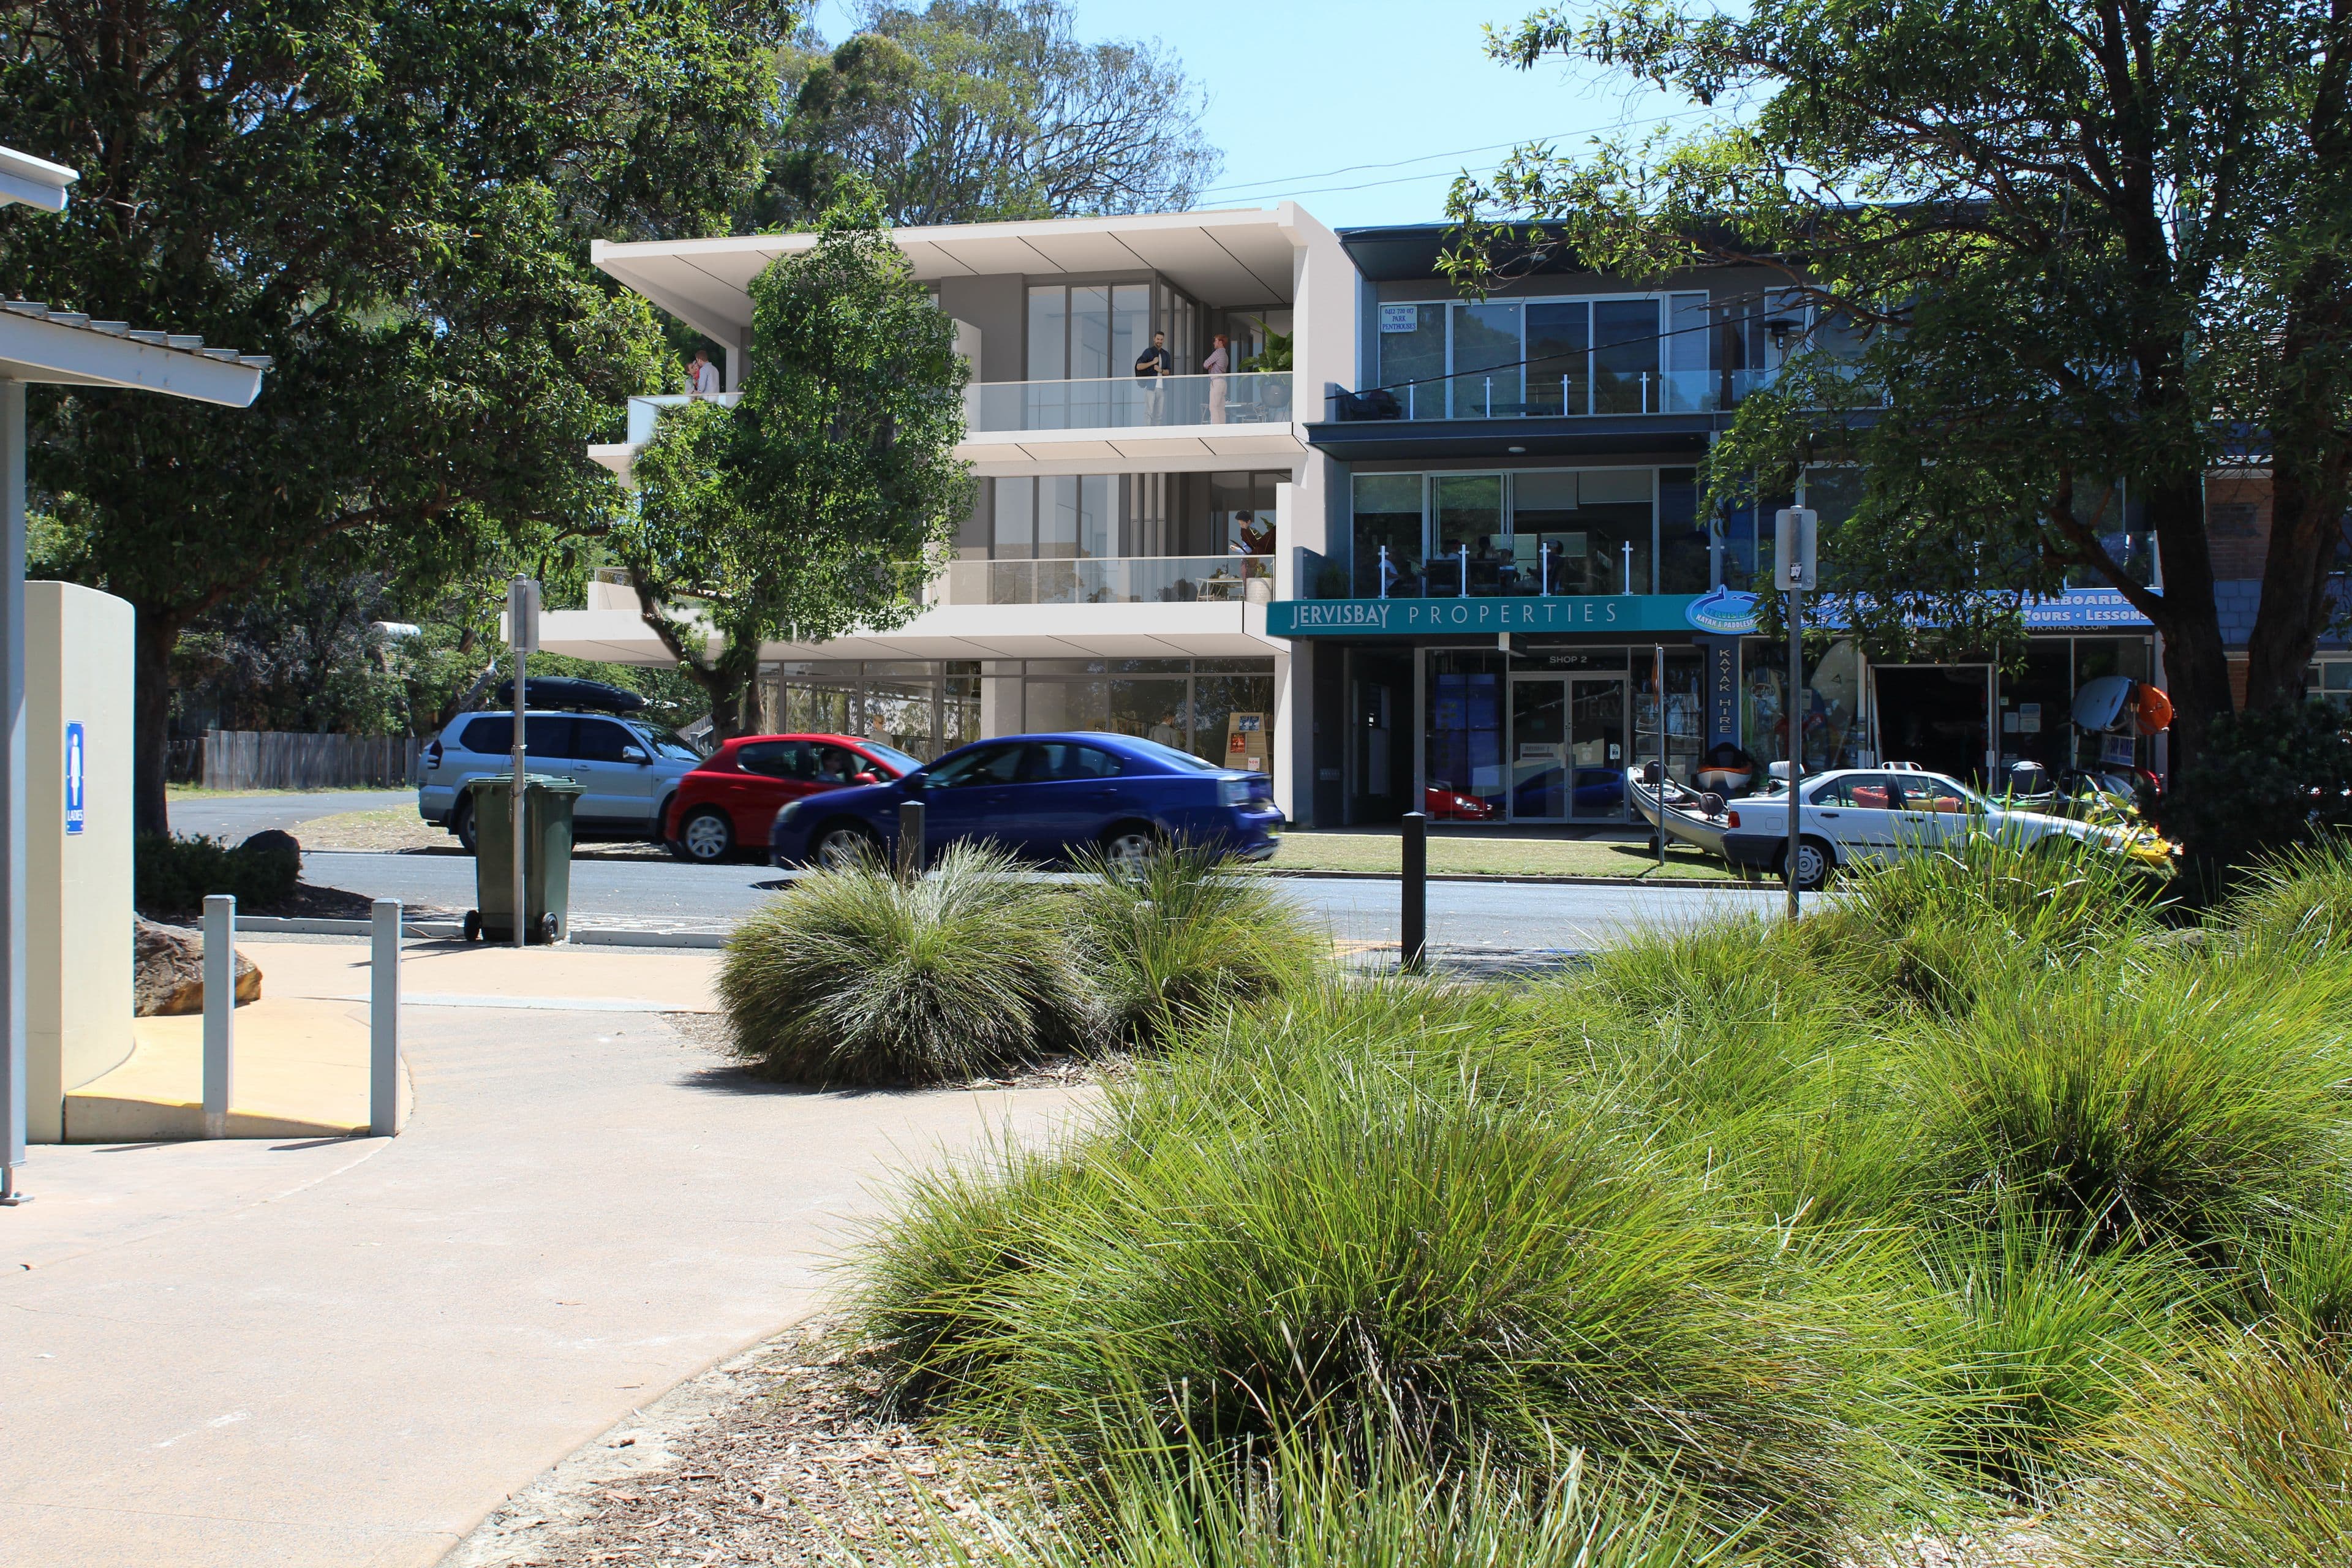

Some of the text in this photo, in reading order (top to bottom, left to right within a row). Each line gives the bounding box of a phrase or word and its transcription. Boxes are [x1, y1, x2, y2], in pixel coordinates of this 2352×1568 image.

[1290, 603, 1616, 629] JERVISBAY PROPERTIES
[1696, 614, 1716, 626] KAYAK
[1719, 650, 1731, 733] KAYAK HIRE
